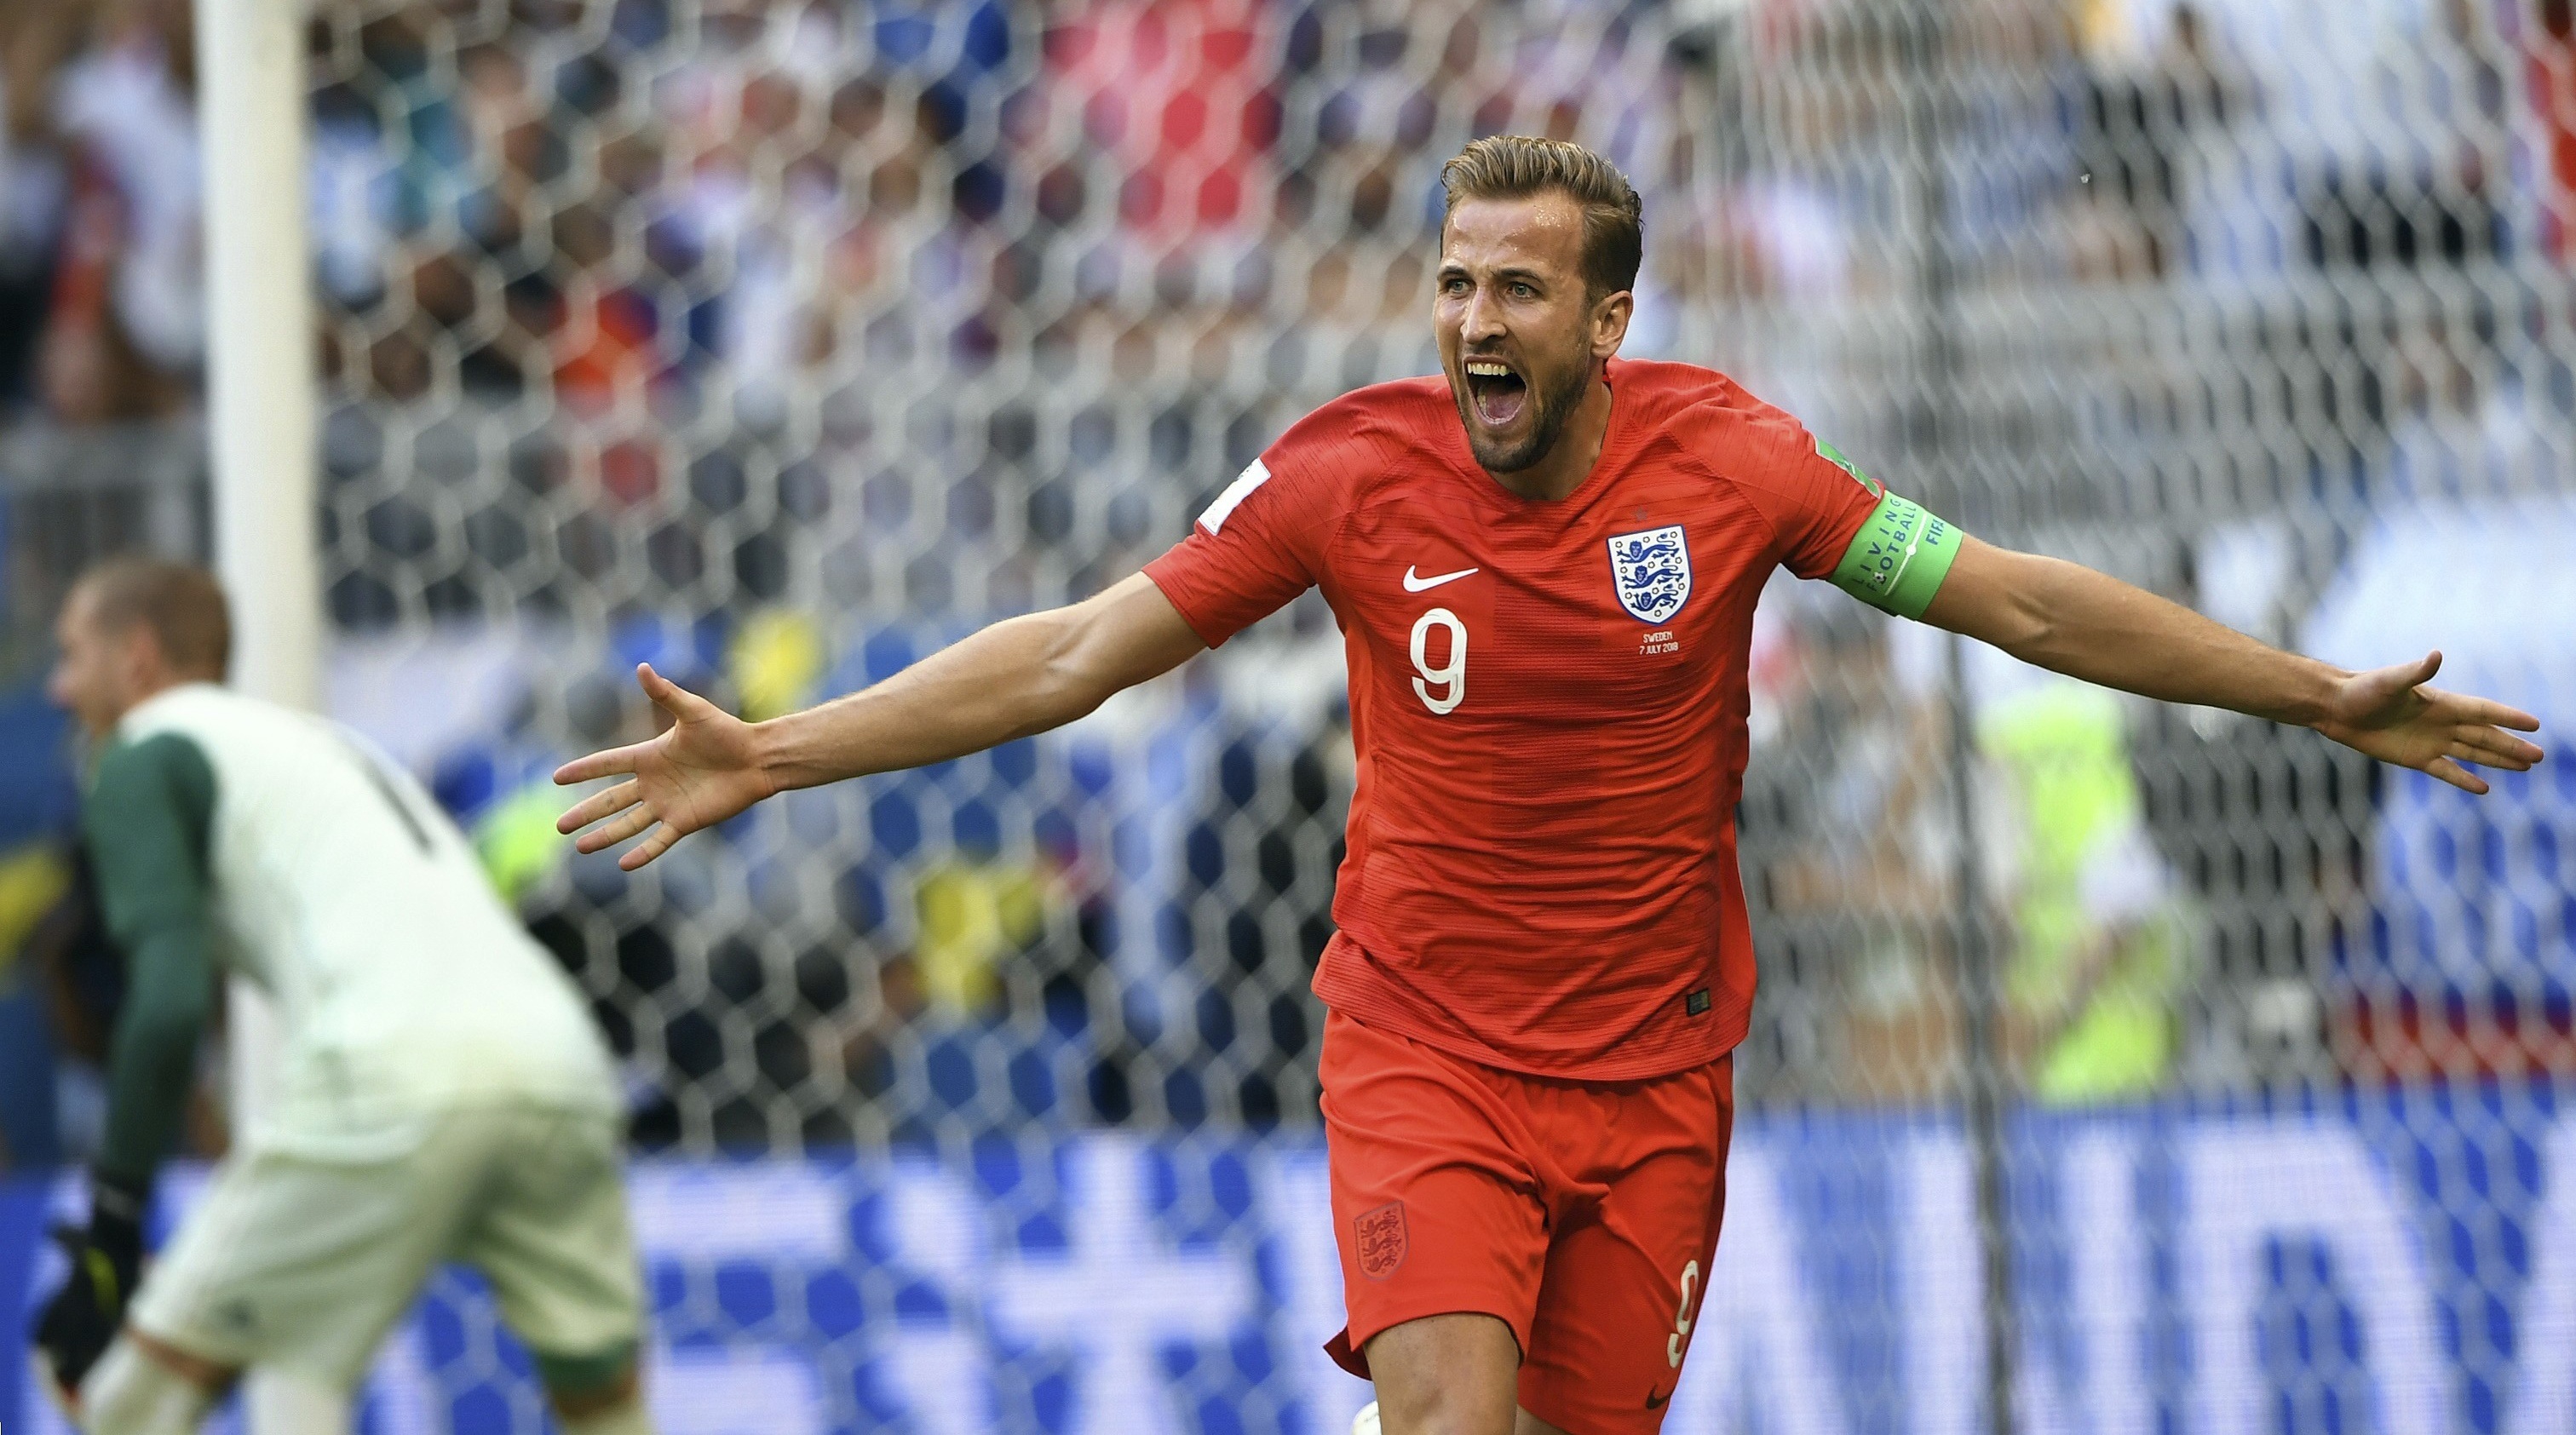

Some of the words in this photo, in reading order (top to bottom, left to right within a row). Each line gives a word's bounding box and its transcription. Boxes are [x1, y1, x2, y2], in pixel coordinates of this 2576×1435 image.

[1853, 499, 1901, 584] LIVING
[1410, 607, 1468, 715] 9
[1639, 646, 1646, 655] 7
[1647, 644, 1662, 655] JULY
[1642, 631, 1673, 643] SWEDEN
[1667, 1260, 1699, 1368] 9
